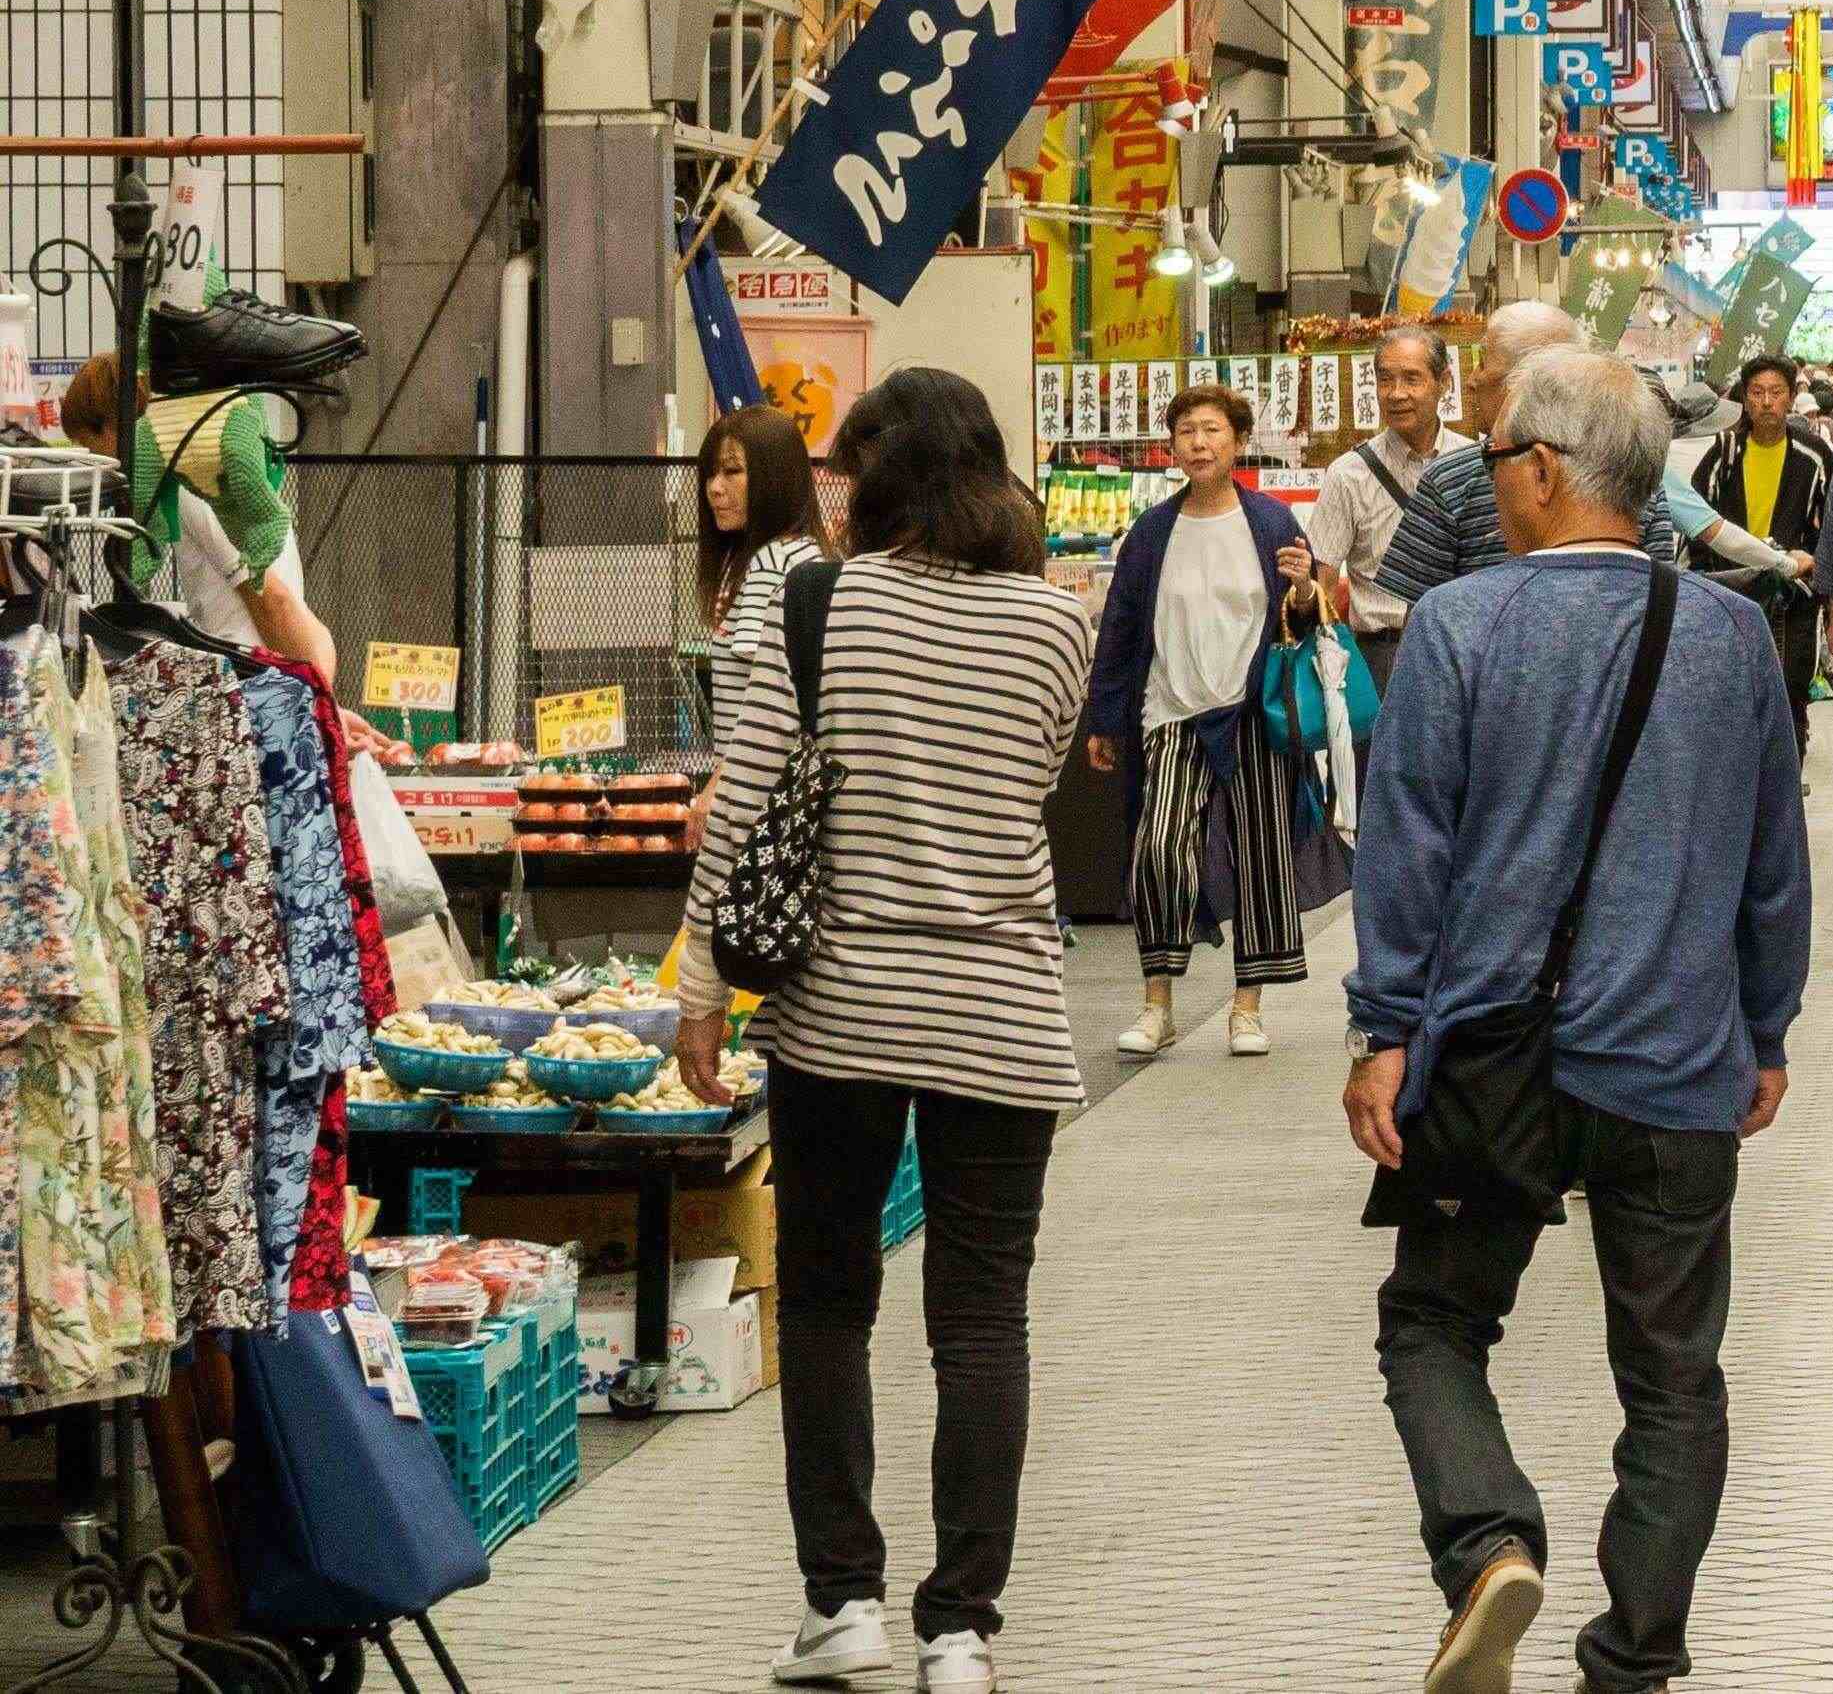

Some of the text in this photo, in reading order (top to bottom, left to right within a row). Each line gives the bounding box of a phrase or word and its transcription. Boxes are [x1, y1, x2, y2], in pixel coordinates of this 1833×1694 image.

[738, 273, 829, 298] 宅急便
[1040, 372, 1060, 435] 静岡茶
[1077, 371, 1096, 434] 玄米茶
[1114, 371, 1133, 434] 昆布茶
[1316, 361, 1337, 425] 宇治茶
[1357, 361, 1377, 425] 玉露
